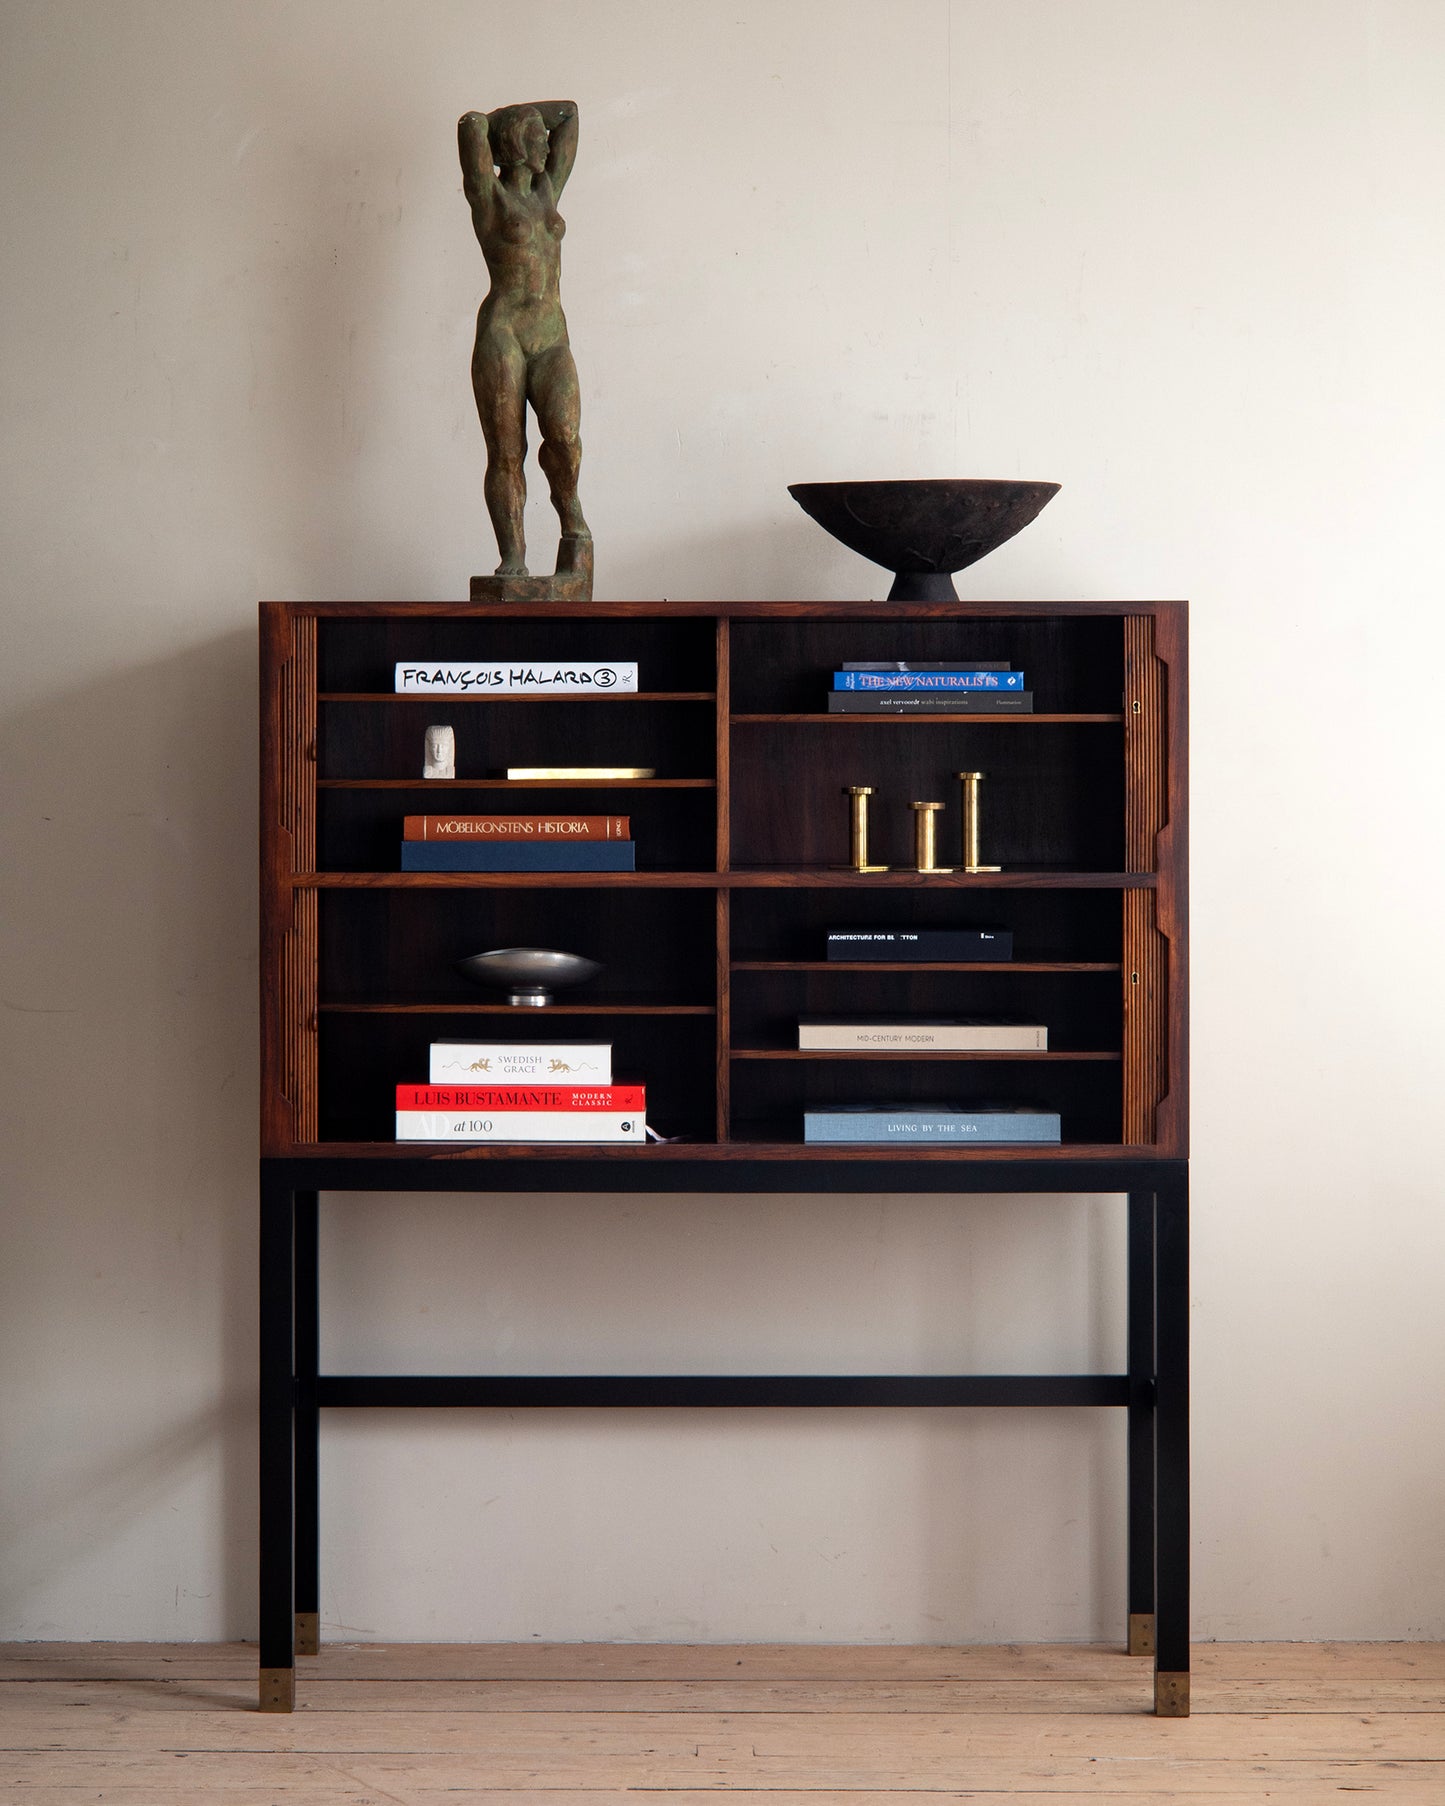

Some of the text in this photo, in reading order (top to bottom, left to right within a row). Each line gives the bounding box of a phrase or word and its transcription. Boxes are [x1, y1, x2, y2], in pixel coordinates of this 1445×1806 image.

[403, 669, 503, 690] FRANÇOIS
[509, 669, 592, 686] HALARD
[859, 675, 884, 687] THE
[887, 675, 916, 687] NEW
[916, 675, 999, 687] NATURALISTS
[436, 821, 590, 834] MÖBELKONSTENS HISTORIA
[856, 1035, 935, 1043] MID-CENTURY MODERN
[497, 1055, 543, 1065] SWEDISH
[503, 1064, 537, 1074] GRACE
[414, 1091, 563, 1106] LUIS BUSTAMANTE
[571, 1092, 614, 1100] MODERN
[571, 1099, 613, 1107] CLASSIC
[453, 1120, 466, 1132] at
[469, 1120, 494, 1133] 100
[887, 1124, 978, 1133] LIVING BY THE SEA
